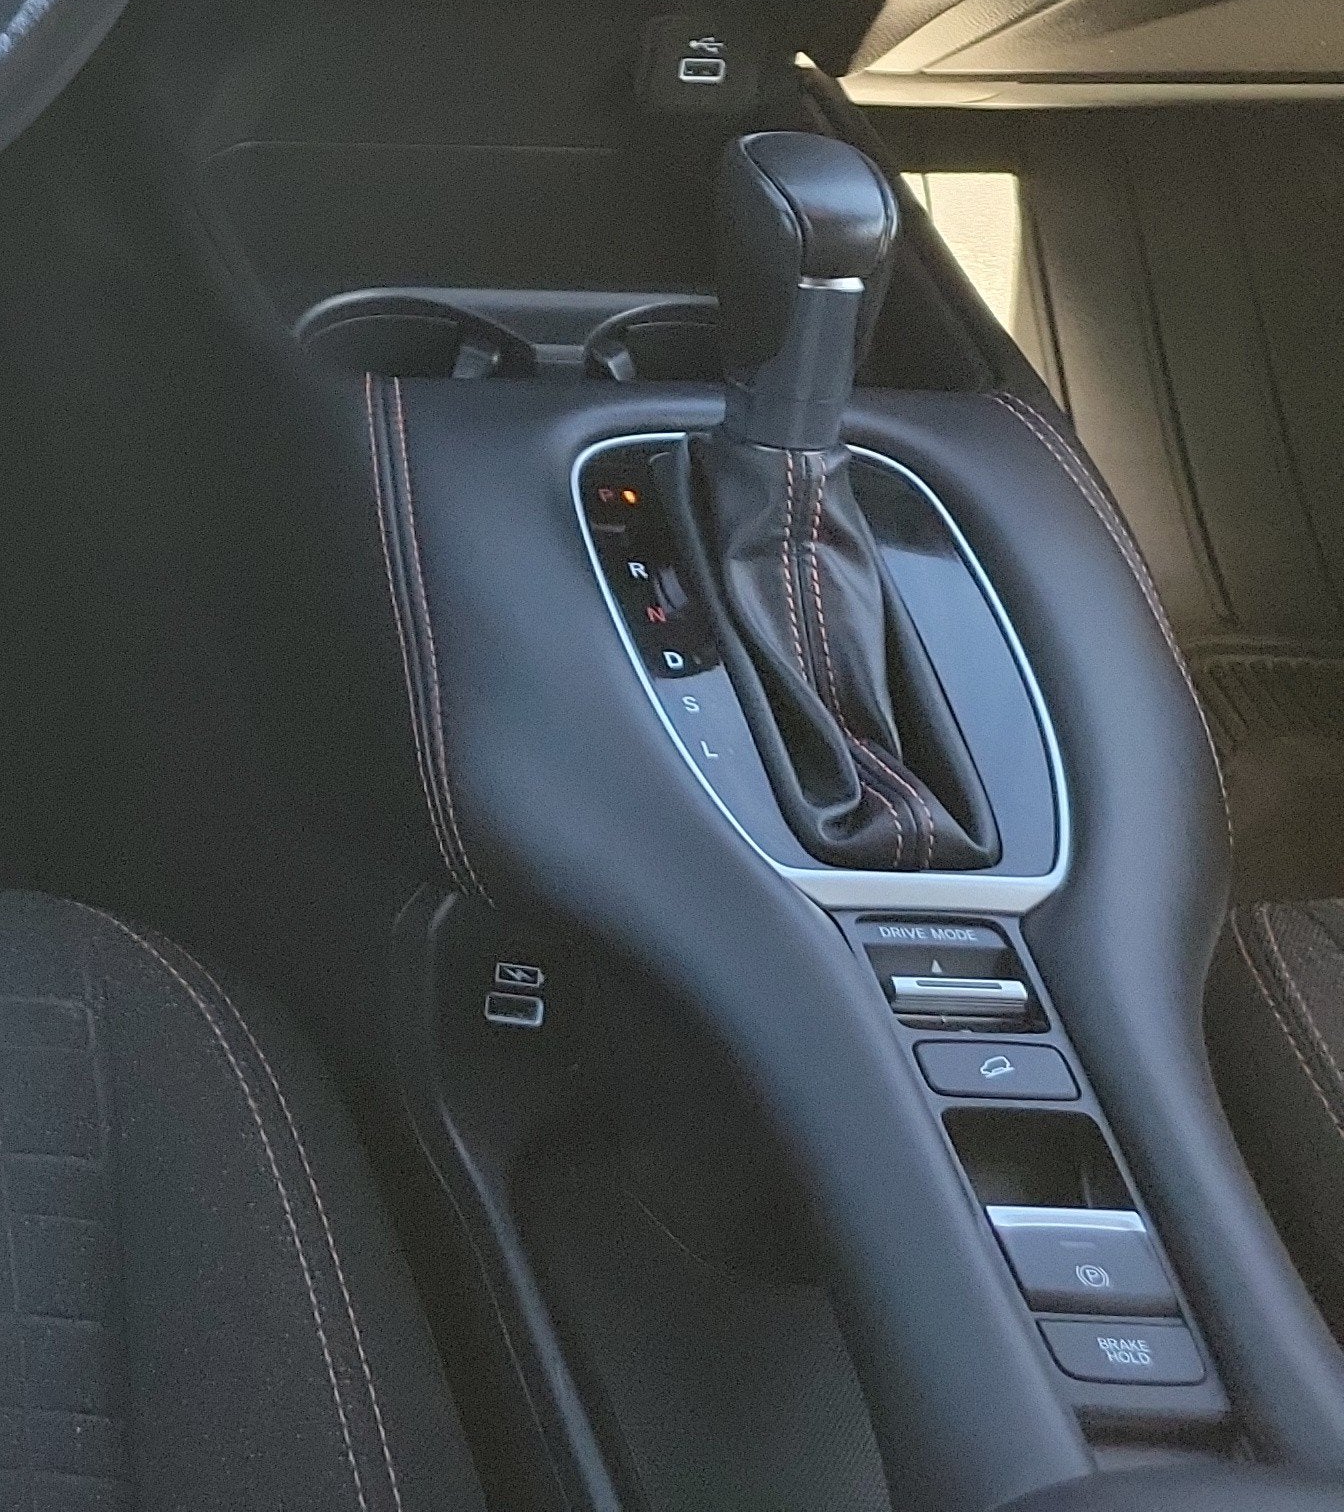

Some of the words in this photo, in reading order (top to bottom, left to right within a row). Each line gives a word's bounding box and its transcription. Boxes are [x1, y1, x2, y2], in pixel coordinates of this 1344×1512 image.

[627, 561, 648, 579] R
[647, 606, 668, 623] N
[663, 651, 684, 670] D
[682, 696, 700, 713] S
[700, 740, 719, 759] L
[879, 926, 928, 940] DRIVE
[930, 928, 979, 942] MODE
[1096, 1337, 1151, 1352] BRAKE
[1106, 1349, 1151, 1365] HOLD
